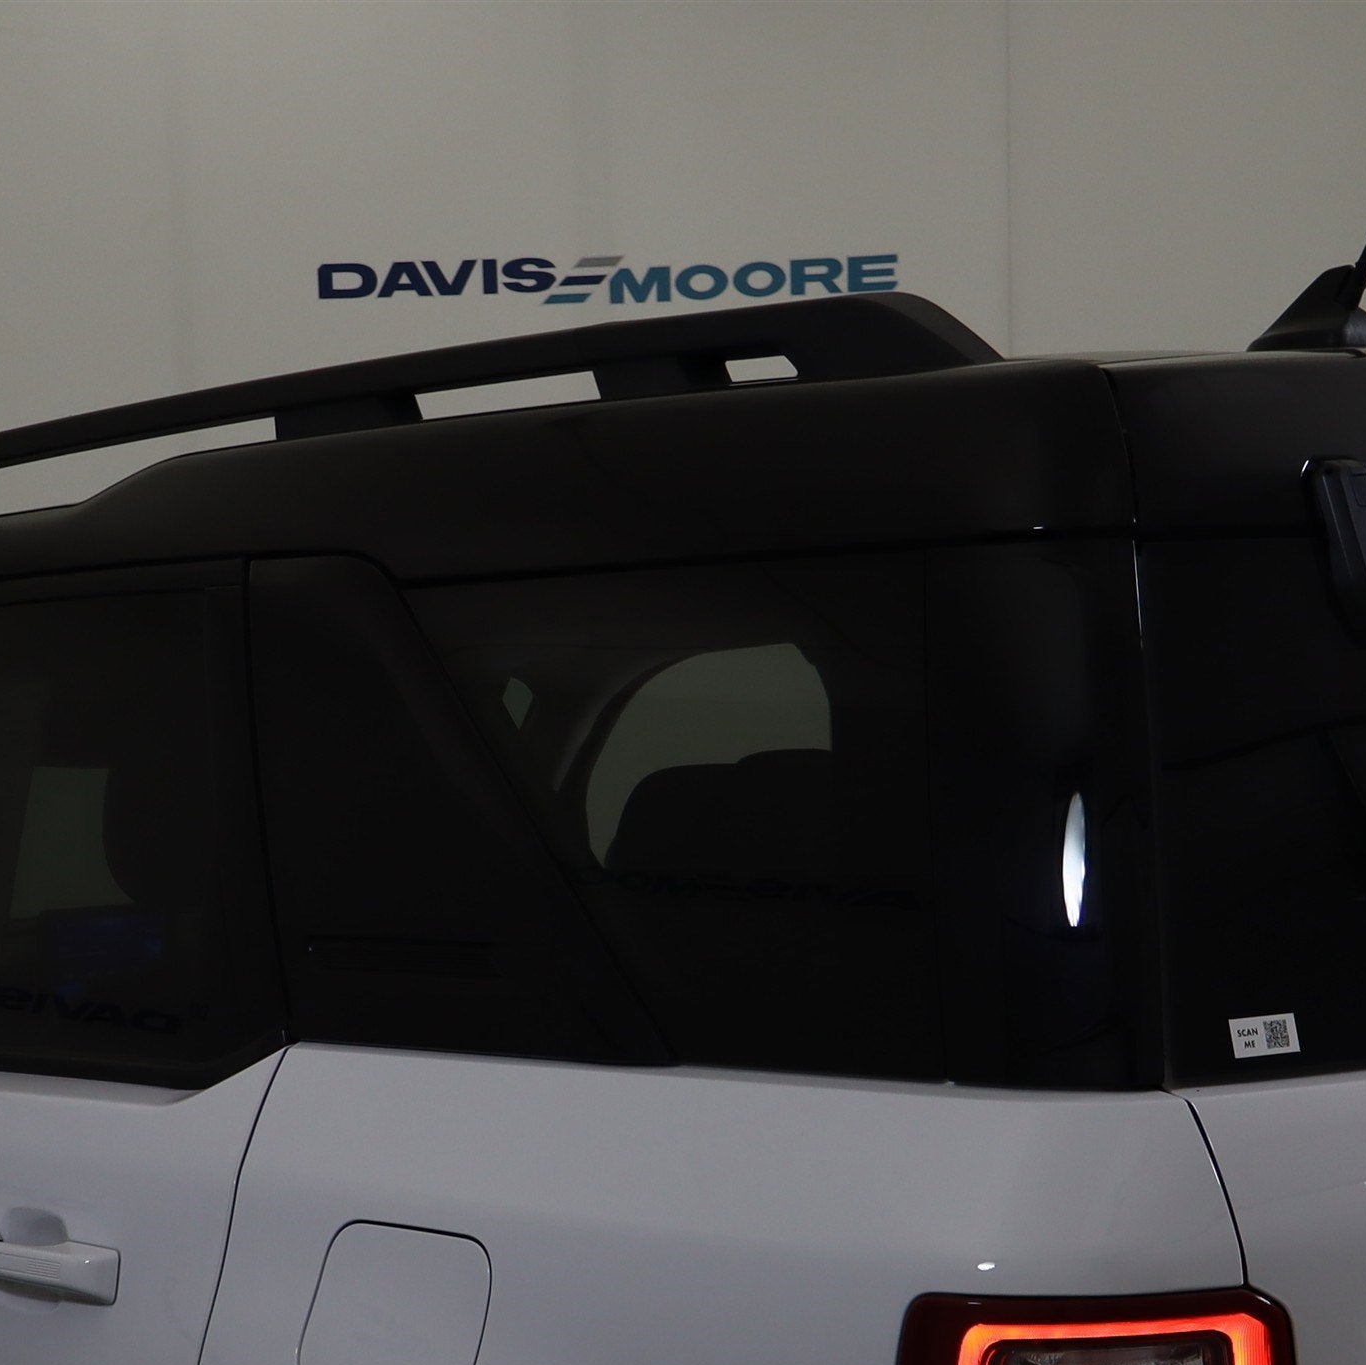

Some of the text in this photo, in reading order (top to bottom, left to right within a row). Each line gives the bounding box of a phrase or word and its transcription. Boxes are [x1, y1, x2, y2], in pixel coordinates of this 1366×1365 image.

[317, 254, 899, 305] DAVIS MOORE
[1236, 1027, 1259, 1038] SCAN
[1244, 1040, 1256, 1049] ME
